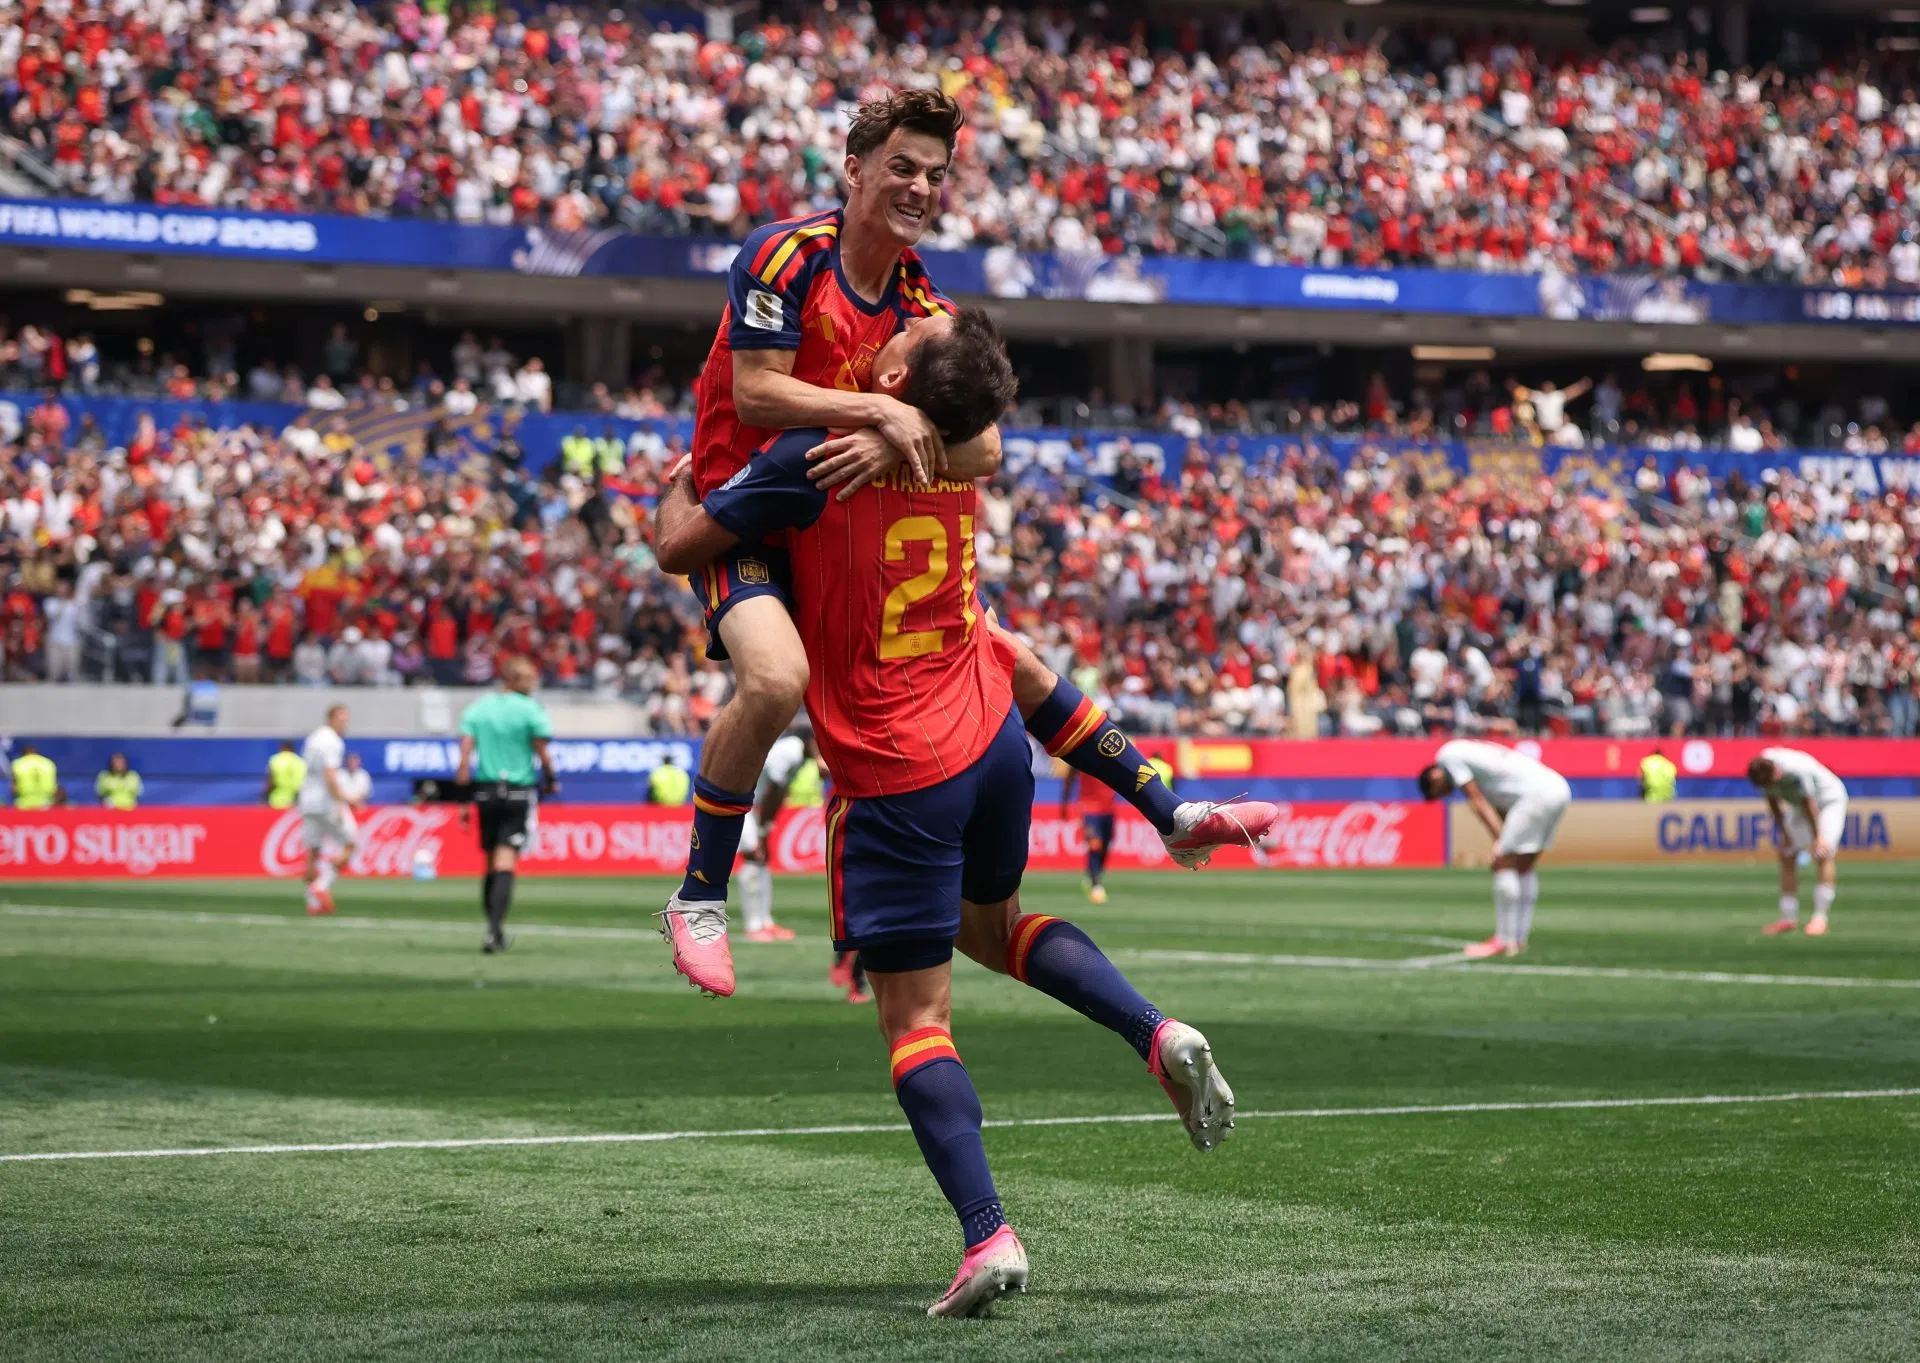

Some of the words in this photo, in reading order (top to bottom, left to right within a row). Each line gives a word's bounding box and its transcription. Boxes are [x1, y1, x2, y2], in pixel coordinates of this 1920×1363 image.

[58, 207, 159, 241] WORLD
[161, 213, 216, 244] CUP
[218, 216, 317, 251] 2026
[880, 515, 976, 659] 21
[384, 741, 448, 772] FIFA
[75, 824, 206, 875] sugar
[609, 820, 694, 869] sug
[1658, 811, 1890, 851] CALIFIA
